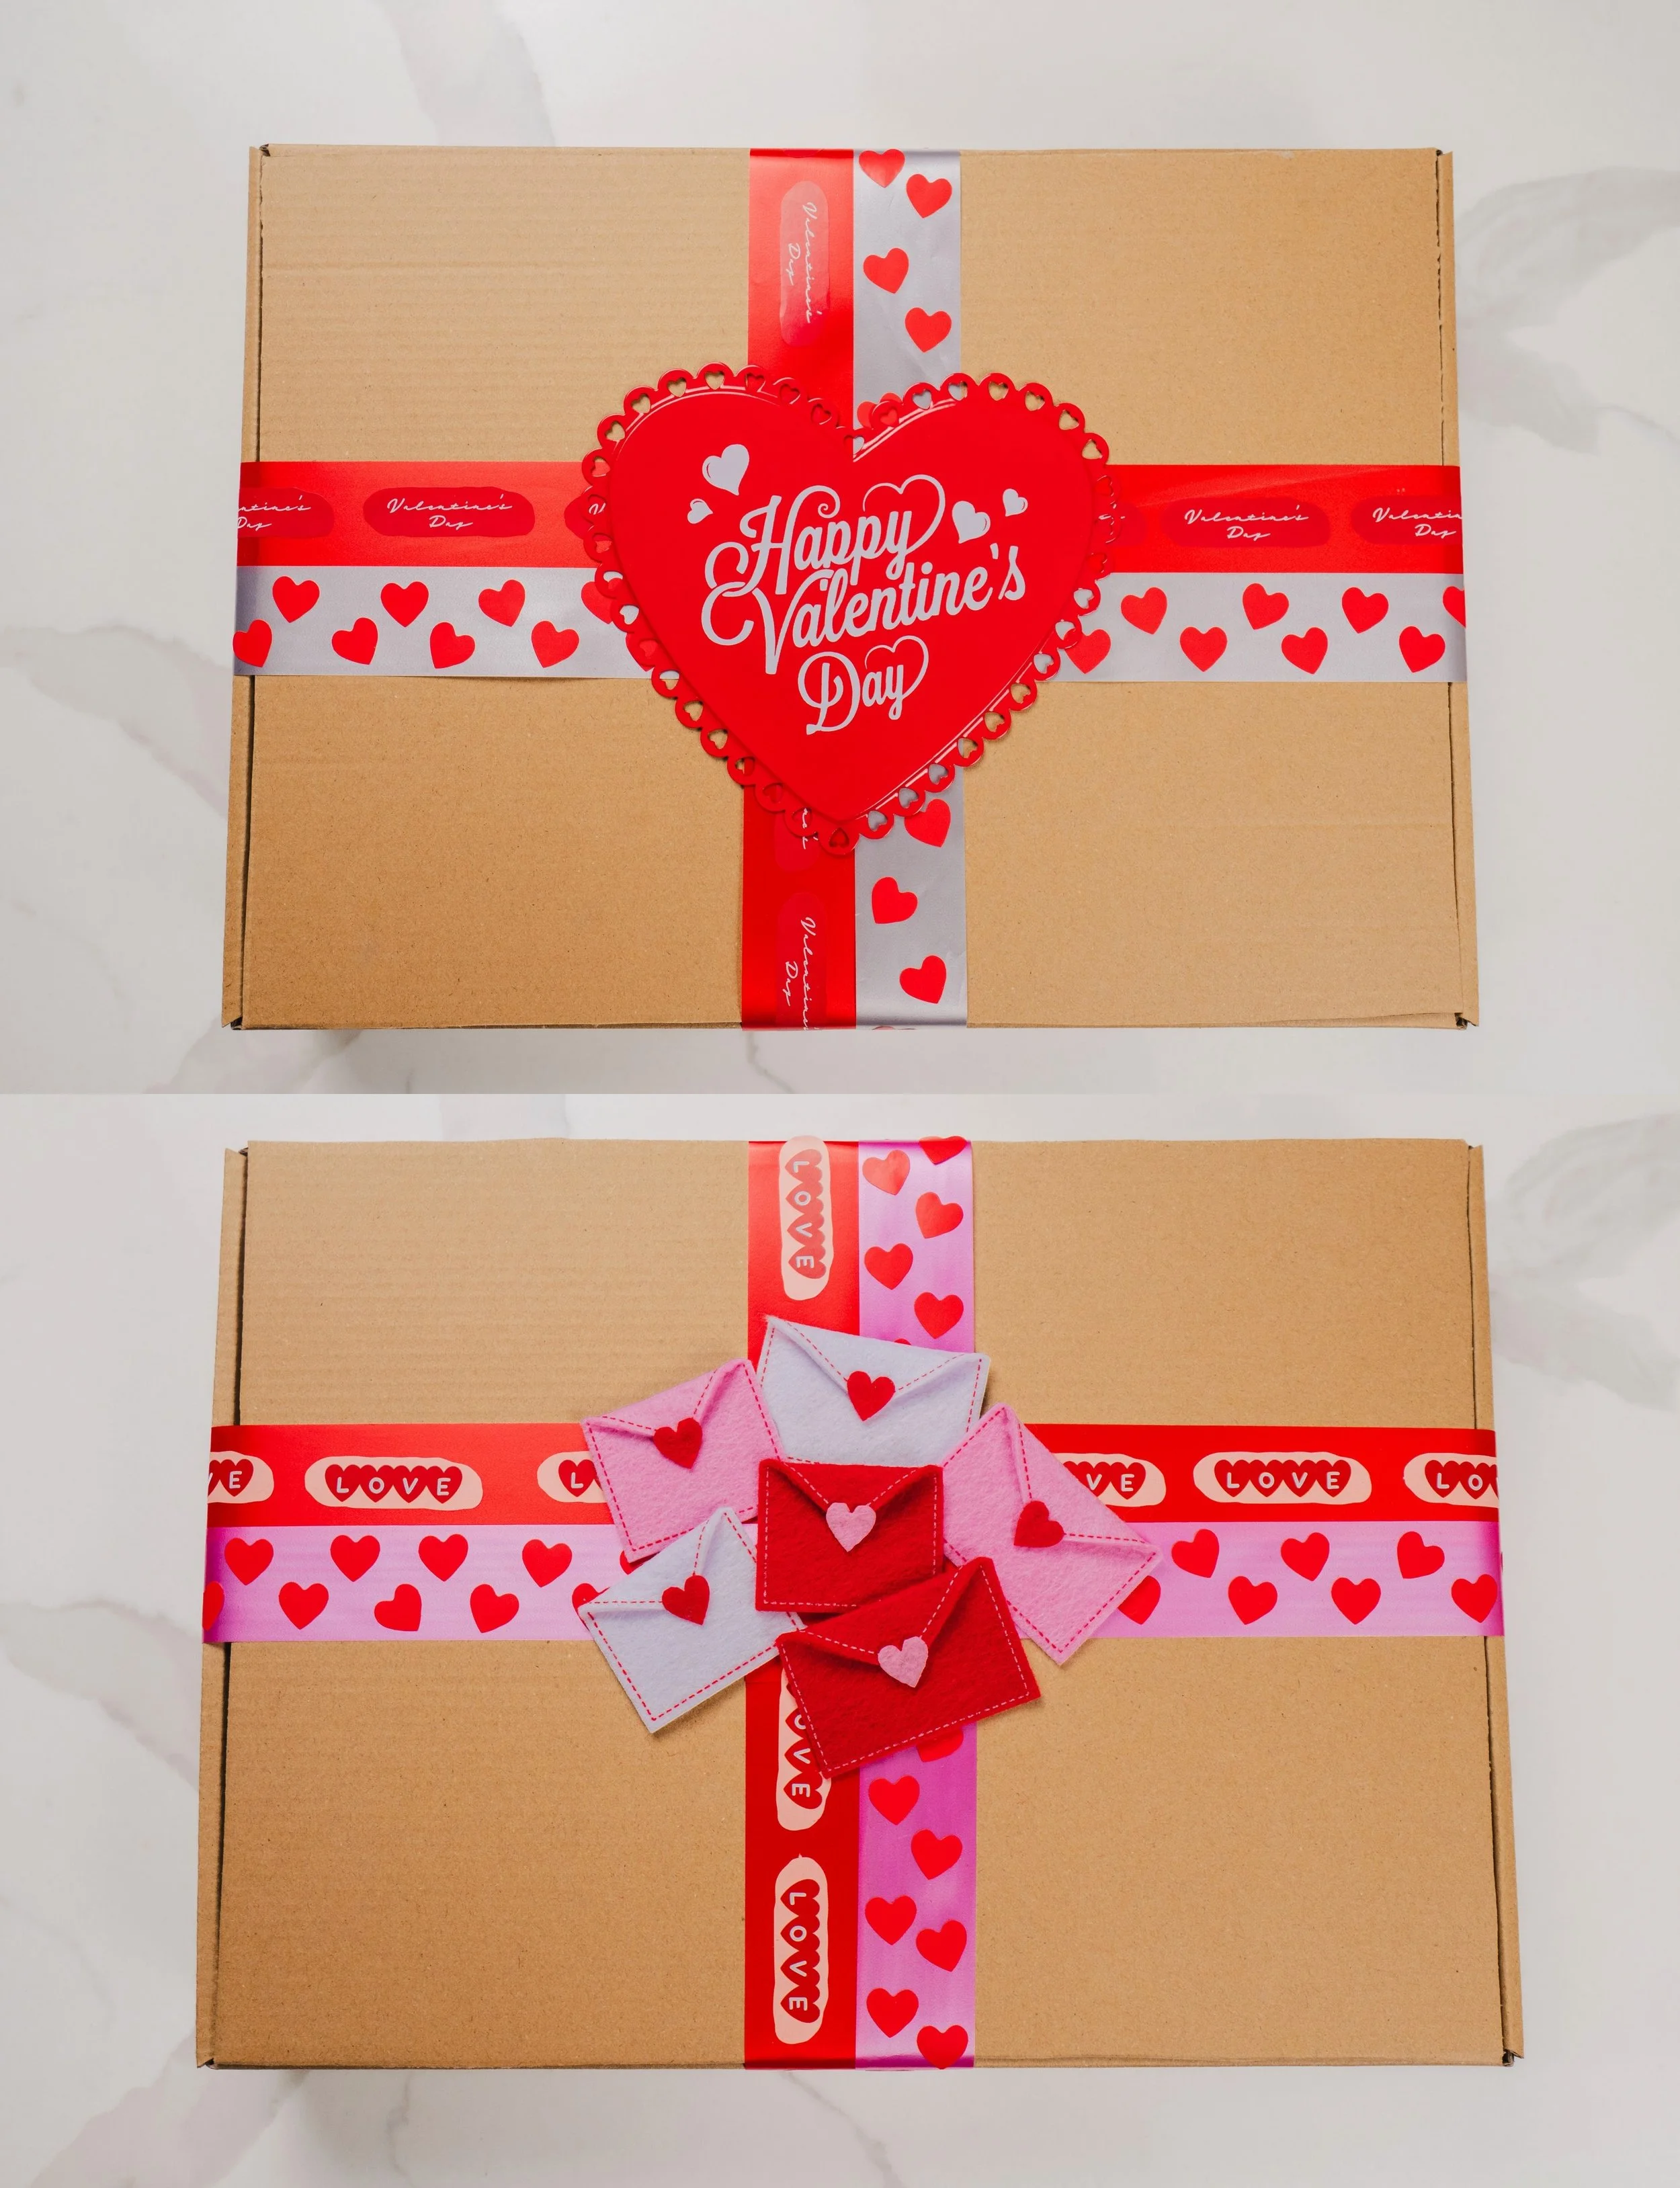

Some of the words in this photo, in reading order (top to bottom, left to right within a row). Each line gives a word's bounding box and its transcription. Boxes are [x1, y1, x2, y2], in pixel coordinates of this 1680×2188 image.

[786, 242, 801, 286] Day
[802, 202, 823, 324] Valentine's
[387, 493, 513, 514] Valentine's
[429, 515, 474, 531] Day
[1184, 505, 1309, 525] Valentine's
[1372, 507, 1463, 523] Valentin
[705, 474, 946, 595] Happy
[1226, 525, 1271, 541] Day
[1415, 523, 1457, 539] Day
[701, 542, 1025, 675] Valentine's
[798, 635, 929, 735] Day
[782, 961, 798, 1007] Day
[793, 1161, 814, 1269] LOVE
[336, 1475, 452, 1497] LOVE
[1086, 1473, 1135, 1492] VE
[1226, 1471, 1341, 1490] LOVE
[1437, 1472, 1484, 1491] LO
[792, 1714, 811, 1798] OVE
[789, 1892, 807, 2011] LOVE
